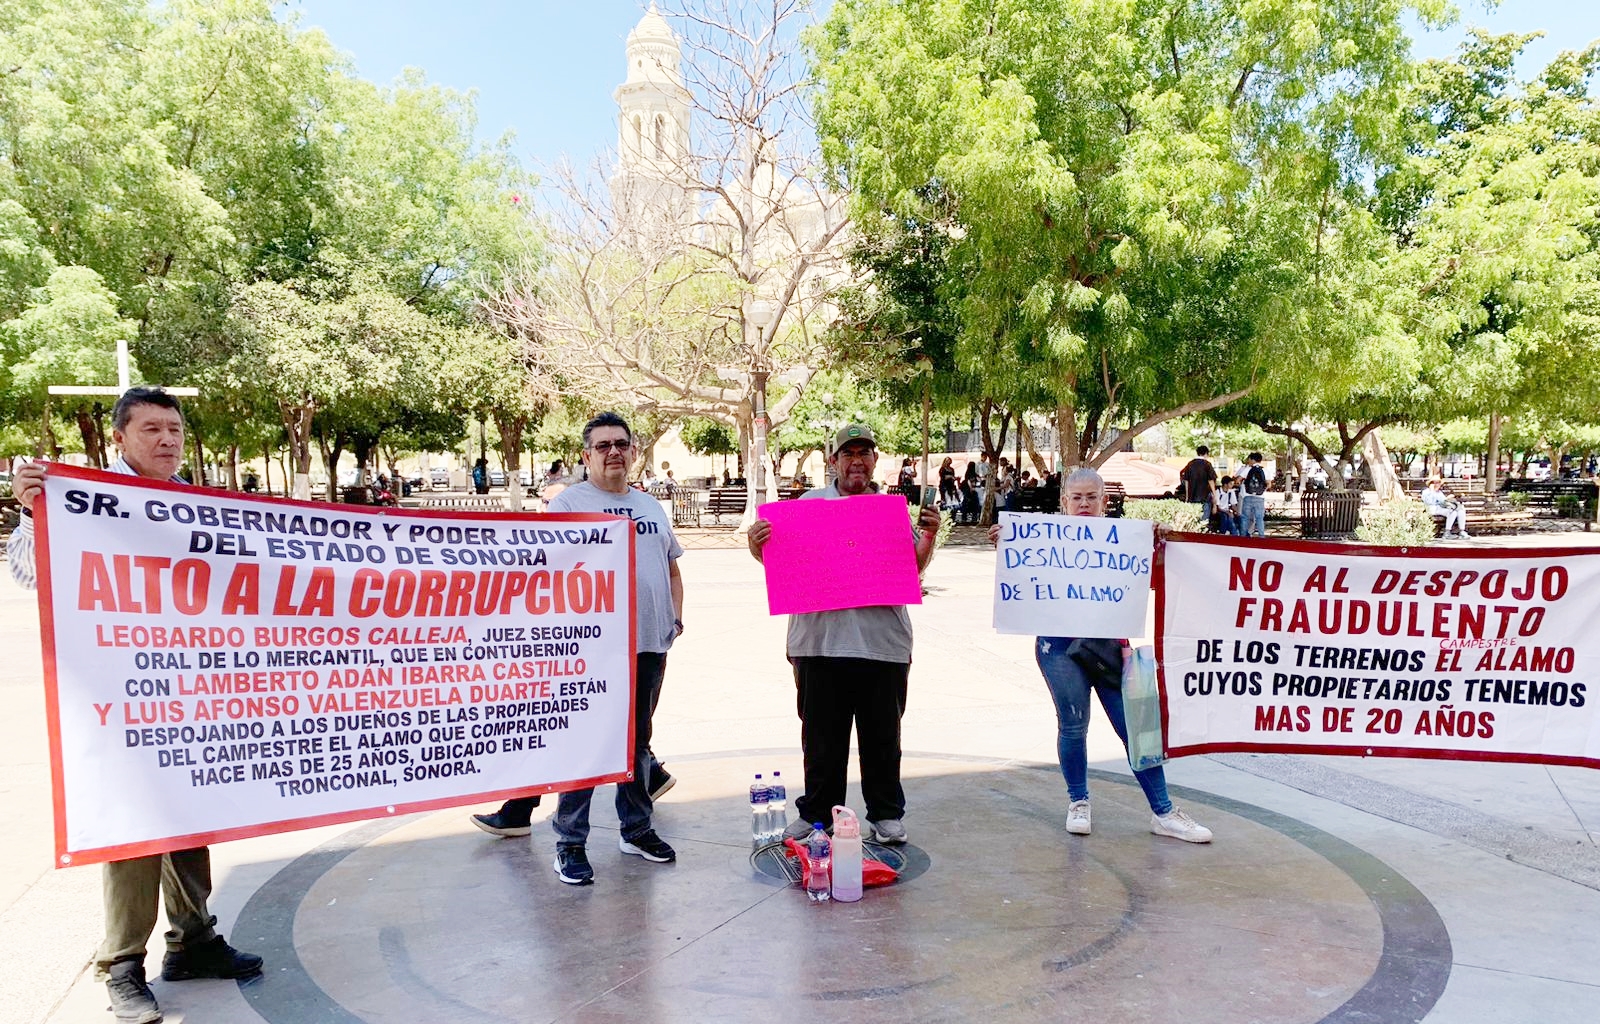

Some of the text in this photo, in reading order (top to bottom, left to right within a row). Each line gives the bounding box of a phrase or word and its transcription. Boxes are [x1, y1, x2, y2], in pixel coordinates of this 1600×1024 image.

[64, 490, 613, 546] SR. GOBERNADOR Y PODER JUDICIAL
[1003, 514, 1120, 544] JUSTICIA A
[189, 531, 548, 567] DEL ESTADO DE SONORA
[1005, 546, 1150, 576] DESALOJADOS
[78, 551, 615, 619] ALTO A LA CORRUPCIÓN
[1000, 582, 1024, 601] DE
[1228, 556, 1569, 602] NO AL DESPOJO
[96, 625, 601, 648] LEOBARDO BURGOS CALLEJA, JUEZ SEGUNDO
[1235, 597, 1546, 639] FRAUDULENTO
[134, 642, 580, 669] ORAL DE LO MERCANTIL, QUE EN CONTUBERNIO
[1196, 639, 1575, 673] DE LOS TERRENOS EL ALAMO
[1439, 637, 1517, 650] CAMPESTRE
[125, 658, 586, 697] CON LAMBERTO ADÁN IBARRA CASTILLO
[1184, 671, 1587, 708] CUYOS PROPIETARIOS TENEMOS
[93, 677, 608, 726] Y LUIS AFONSO VALENZUELA DUARTE, ESTÁN
[125, 698, 589, 748] DESPOJANDO A LOS DUEÑOS DE LAS PROPIEDADES
[1254, 704, 1496, 739] MAS DE 20 AÑOS
[158, 716, 569, 768] DEL CAMPESTRE EL ALAMO QUE COMPRARON
[190, 734, 547, 787] HACE MAS DE 25 AÑOS, UBICADO EN EL
[275, 760, 481, 798] TRONCONAL, SONORA.
